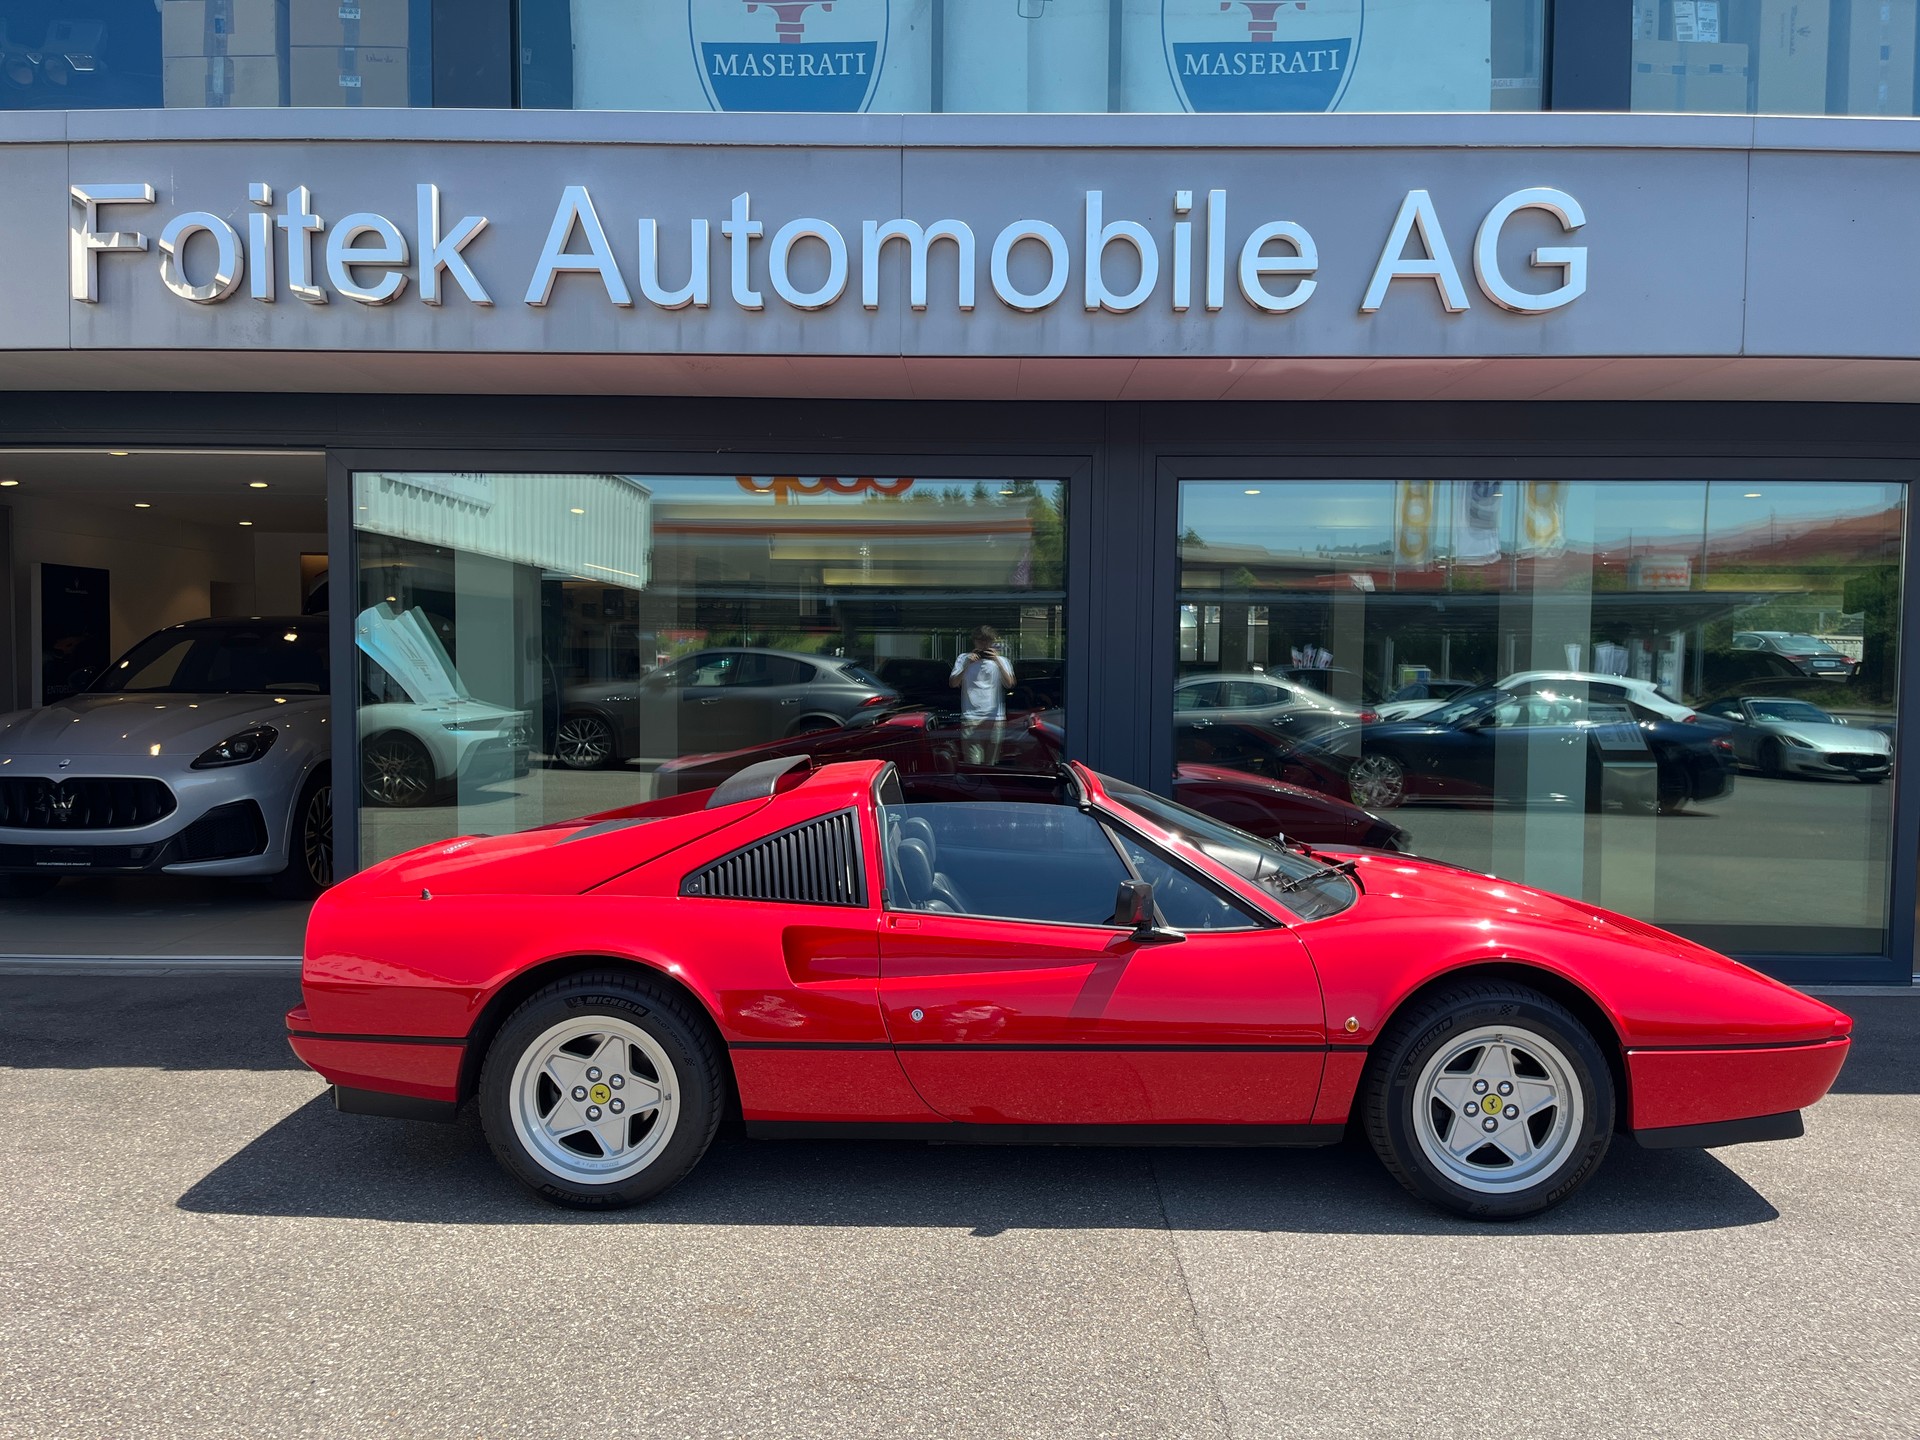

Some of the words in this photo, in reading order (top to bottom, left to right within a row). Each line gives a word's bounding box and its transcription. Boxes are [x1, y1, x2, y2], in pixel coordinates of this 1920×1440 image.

[713, 51, 867, 77] MASERATI
[1184, 48, 1340, 77] MASERATI
[70, 182, 495, 306] Foitek
[524, 184, 1320, 313] Automobile
[1359, 187, 1588, 314] AG
[585, 996, 647, 1016] MICHELIN
[652, 1015, 670, 1030] PILOT
[670, 1031, 686, 1051] SPORT
[1408, 1018, 1452, 1064] MICHELIN
[1548, 1157, 1592, 1201] MICHELIN
